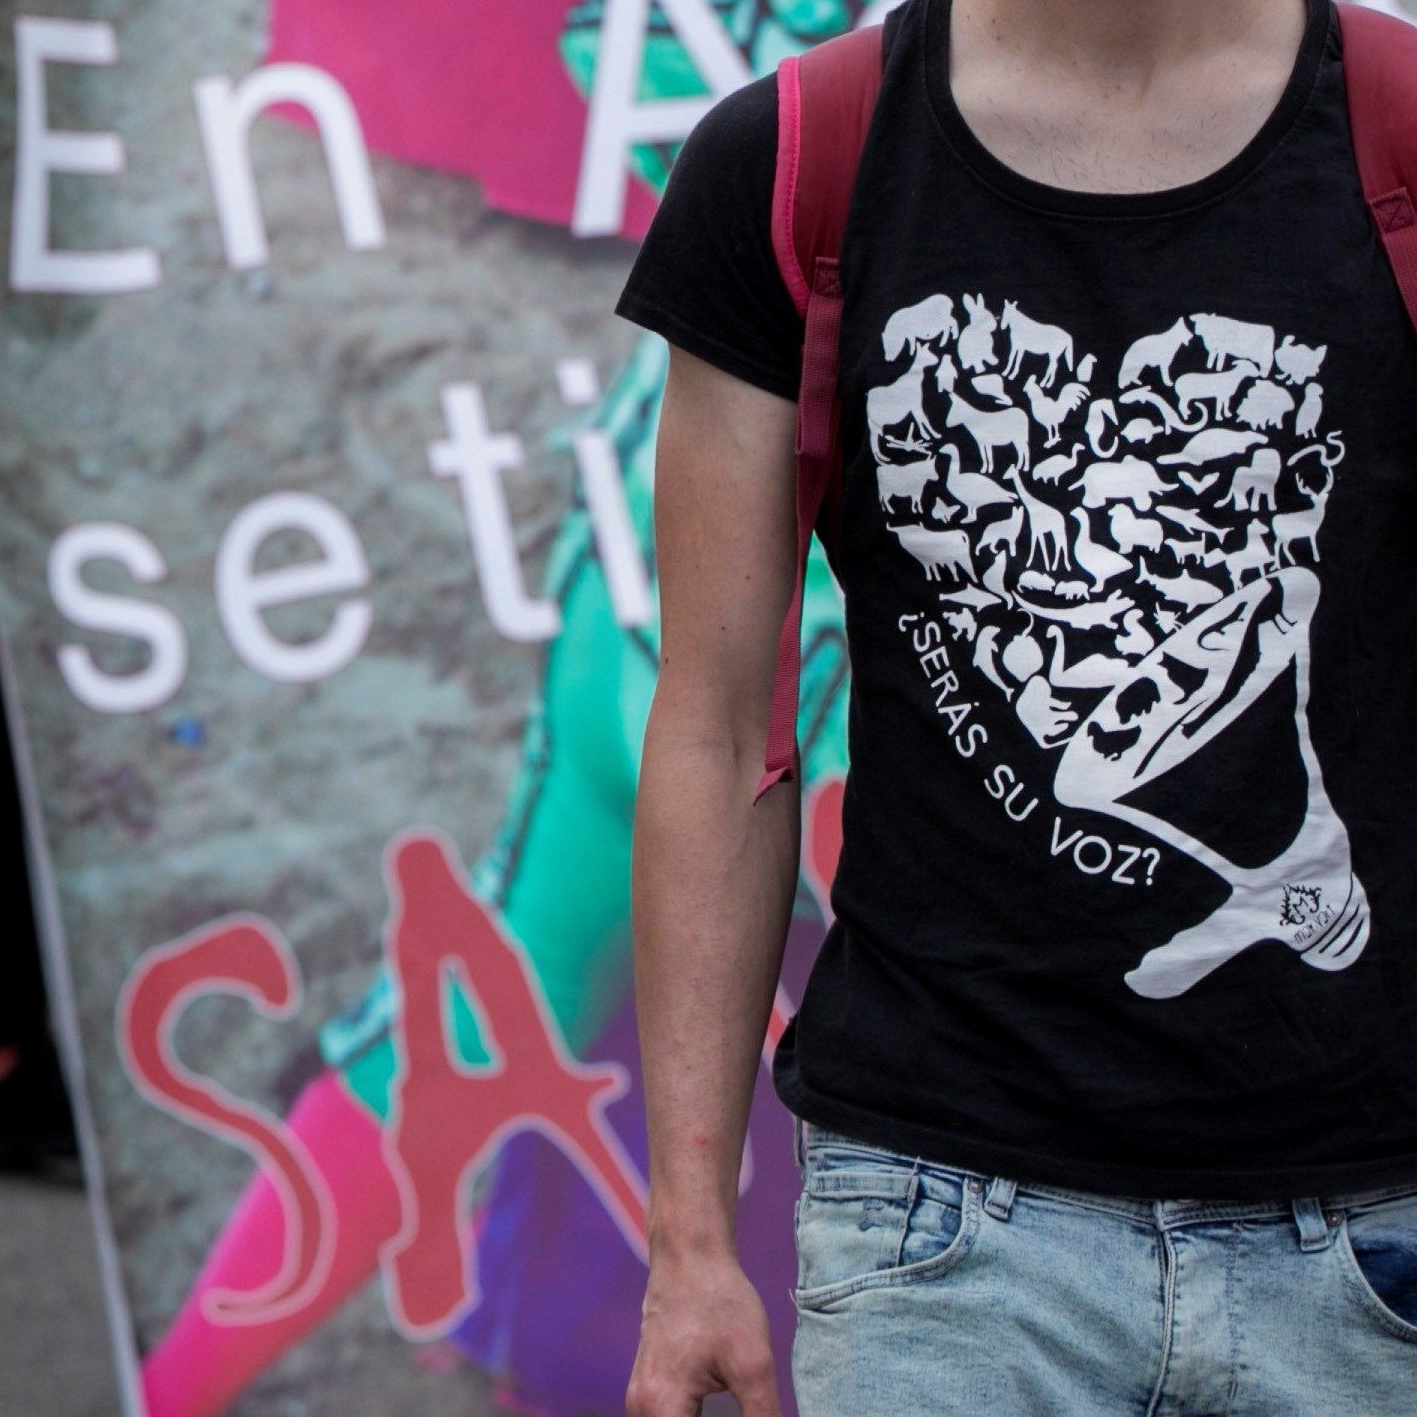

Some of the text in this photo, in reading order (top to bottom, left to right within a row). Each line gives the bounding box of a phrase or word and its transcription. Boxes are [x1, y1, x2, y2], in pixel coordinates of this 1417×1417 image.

[10, 13, 387, 295] En
[899, 611, 1161, 886] ¿SERÁS SU VOZ?
